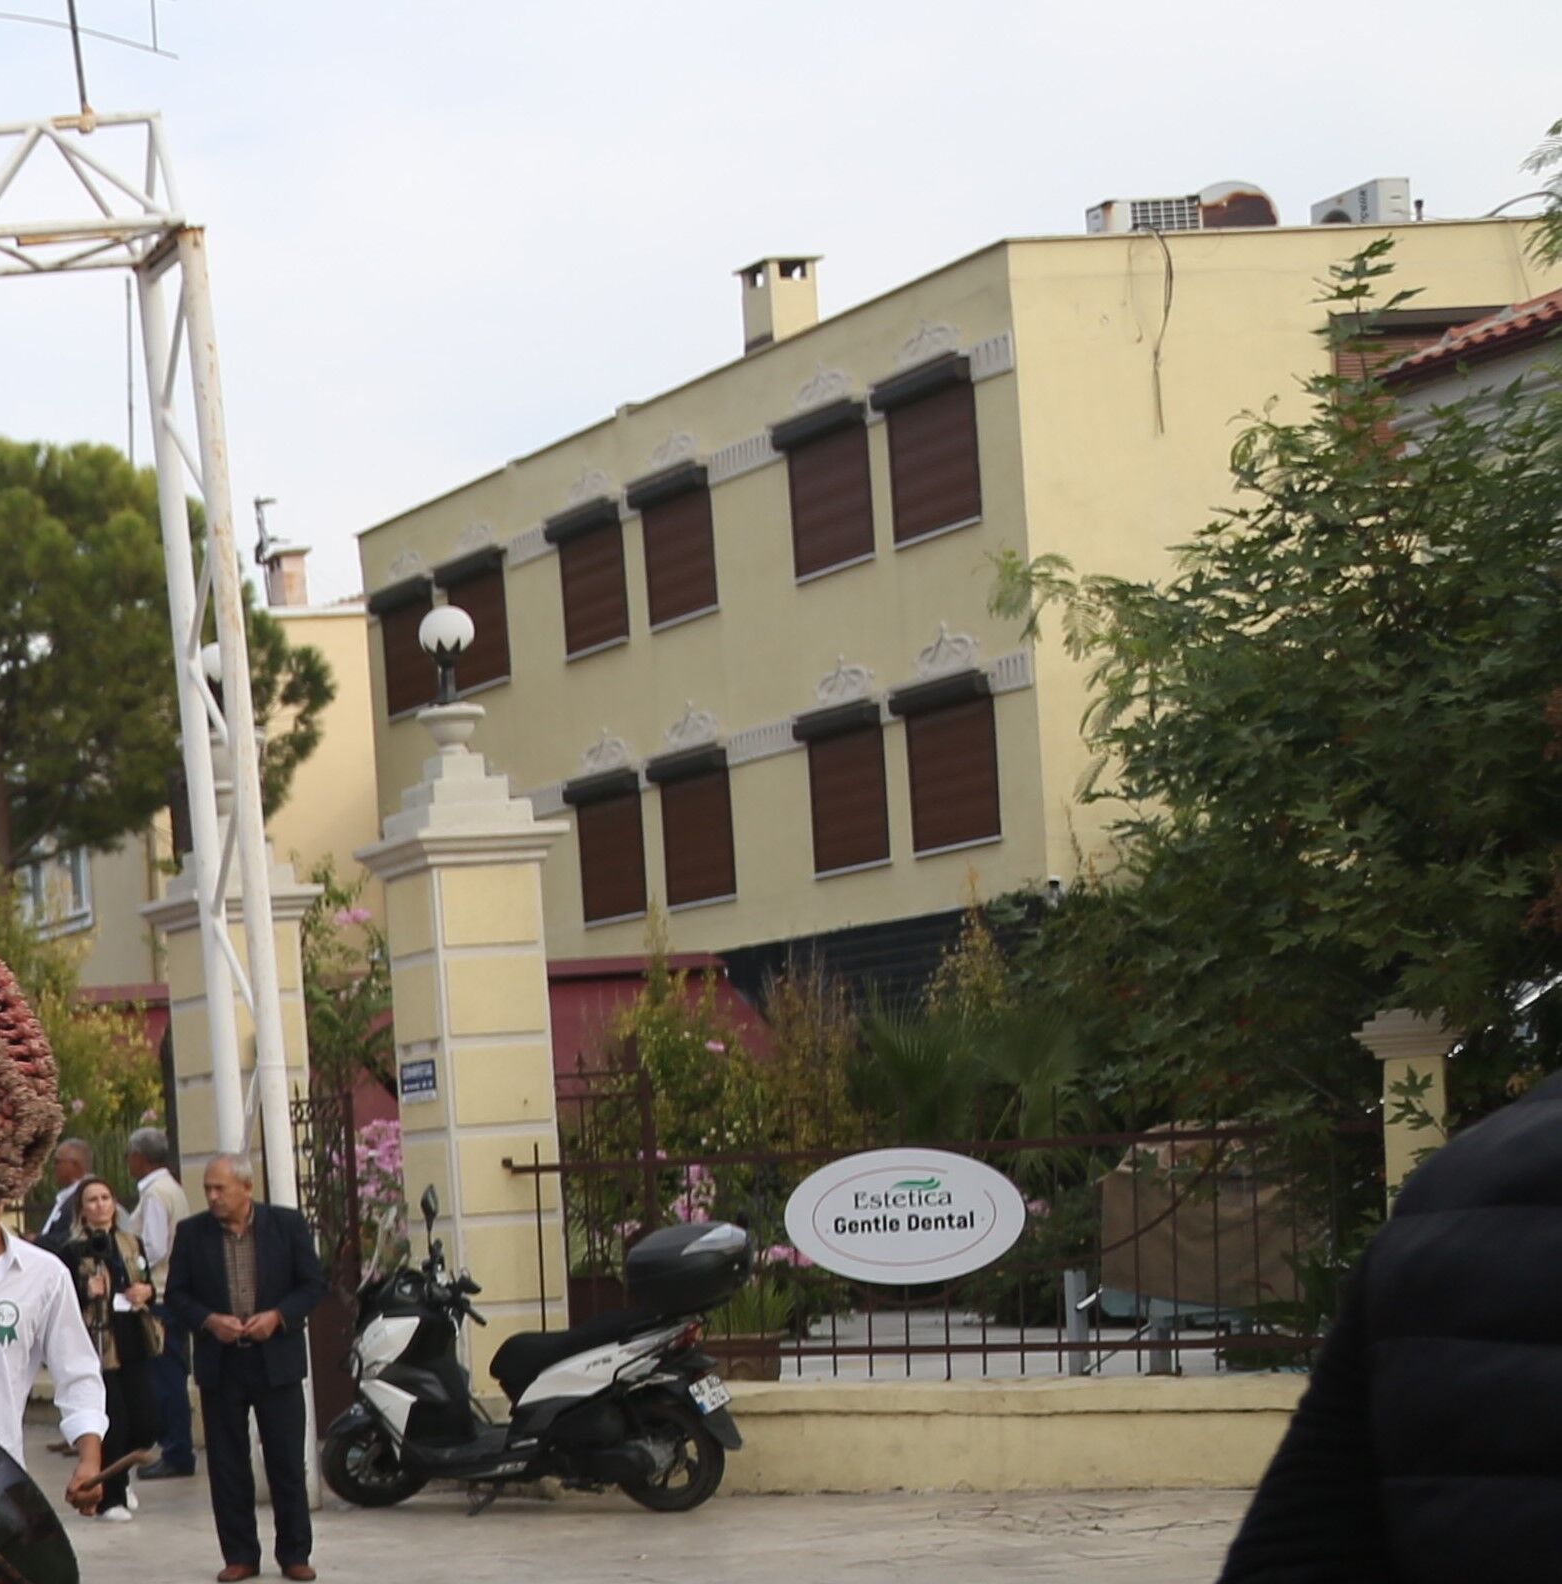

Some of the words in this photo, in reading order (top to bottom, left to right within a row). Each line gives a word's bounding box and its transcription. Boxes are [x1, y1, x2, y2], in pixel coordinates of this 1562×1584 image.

[854, 1188, 953, 1210] Estetica
[834, 1214, 900, 1234] Gentle
[907, 1211, 974, 1231] Dental
